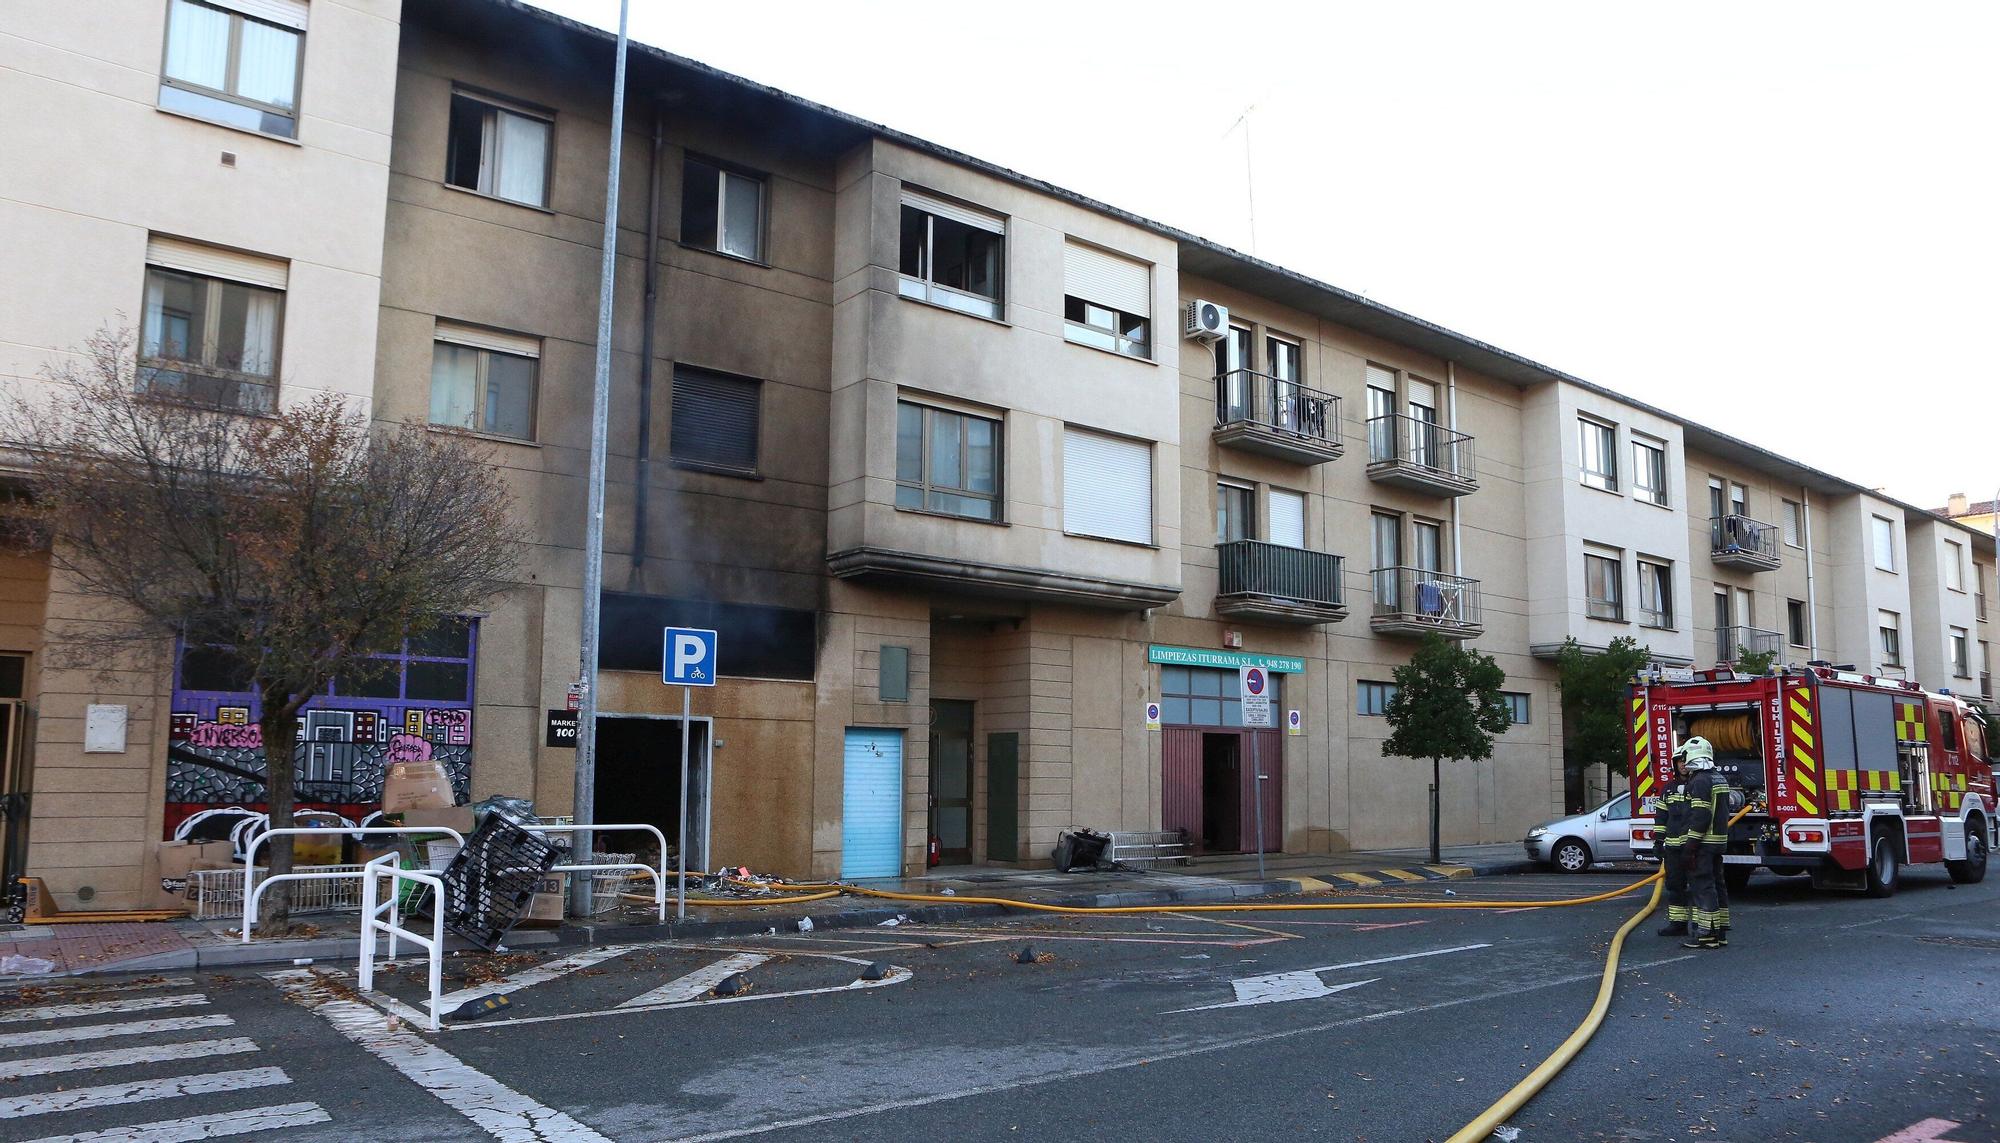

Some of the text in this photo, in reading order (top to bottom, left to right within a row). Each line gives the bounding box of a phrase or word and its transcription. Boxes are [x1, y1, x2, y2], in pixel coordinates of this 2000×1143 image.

[674, 634, 707, 678] P
[1152, 650, 1197, 662] LIMPIEZAS
[1198, 654, 1240, 666] ITURRAMA
[1266, 660, 1278, 669] 948
[1279, 660, 1290, 670] 278
[1291, 661, 1302, 671] 190
[556, 728, 575, 738] 100
